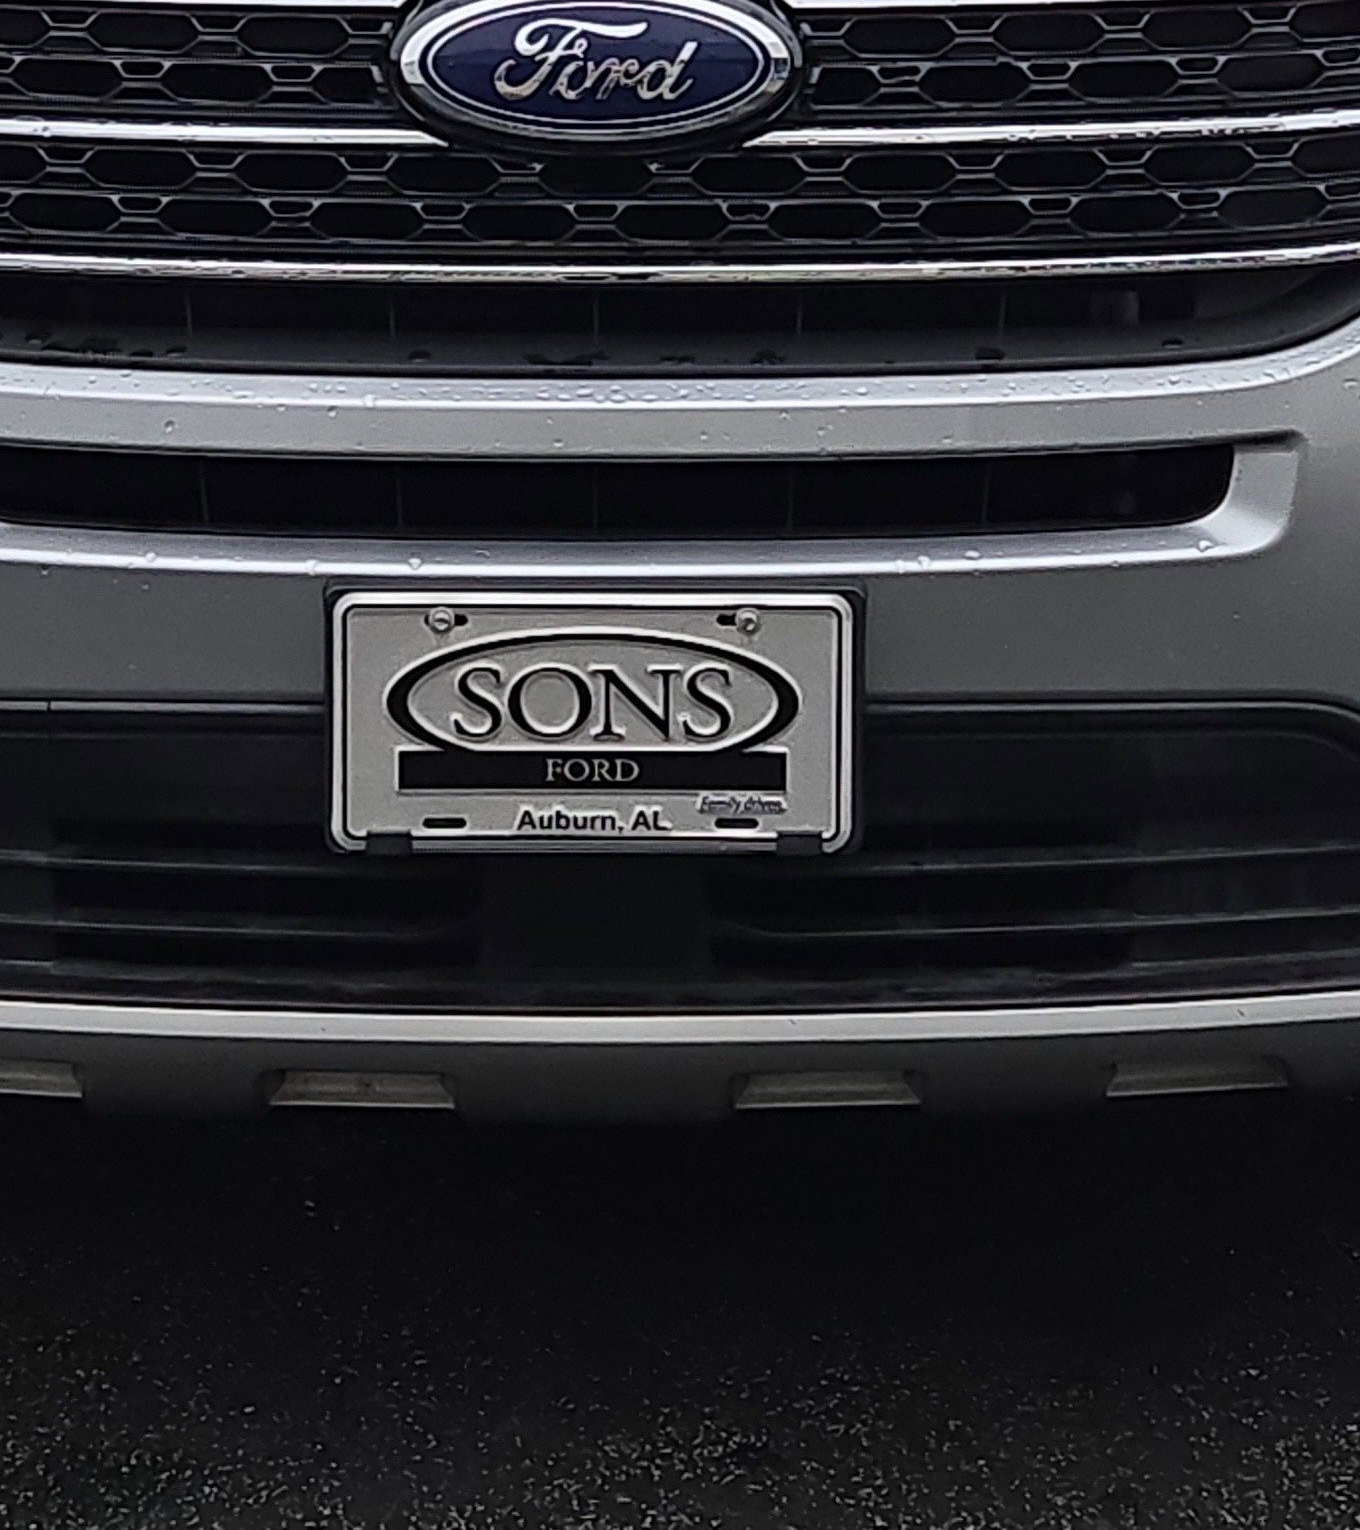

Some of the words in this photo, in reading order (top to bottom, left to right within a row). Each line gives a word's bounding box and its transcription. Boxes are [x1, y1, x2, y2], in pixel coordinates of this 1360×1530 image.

[493, 17, 698, 102] Ford
[451, 665, 733, 740] SONS
[544, 757, 641, 783] FORD
[516, 809, 625, 835] Auburn,
[630, 809, 672, 832] AL
